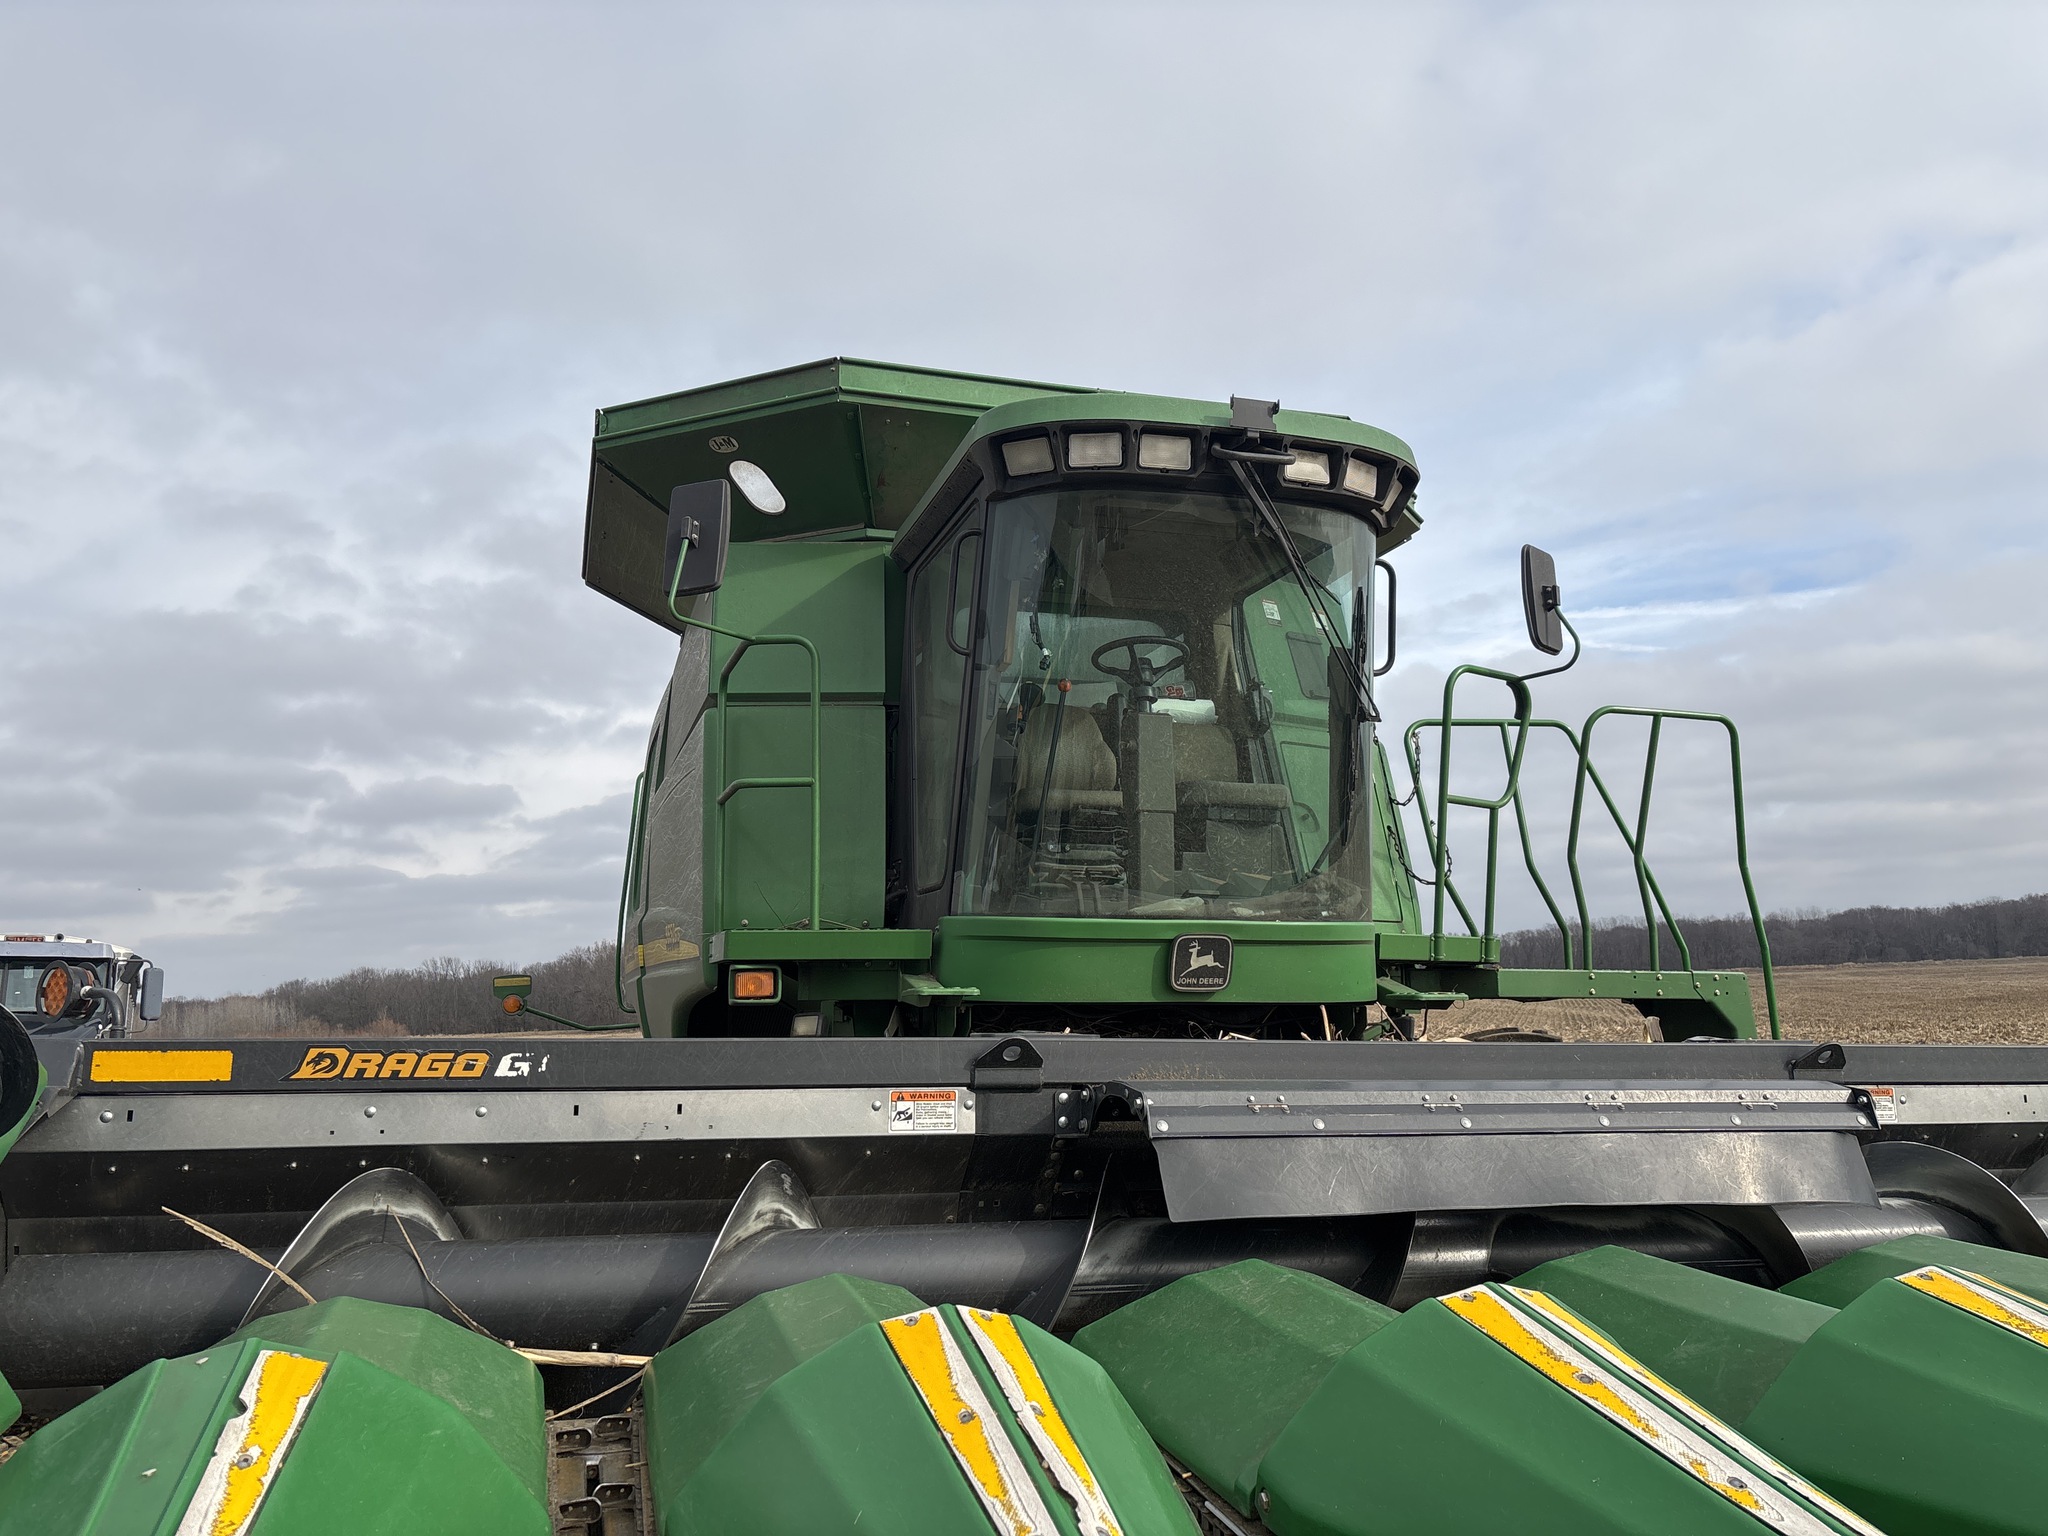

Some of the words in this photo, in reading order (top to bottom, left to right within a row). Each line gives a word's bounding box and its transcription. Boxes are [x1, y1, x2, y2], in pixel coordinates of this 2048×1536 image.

[1177, 977, 1198, 985] JOHN
[1199, 977, 1225, 985] DEERE
[289, 1047, 490, 1078] DRAGO
